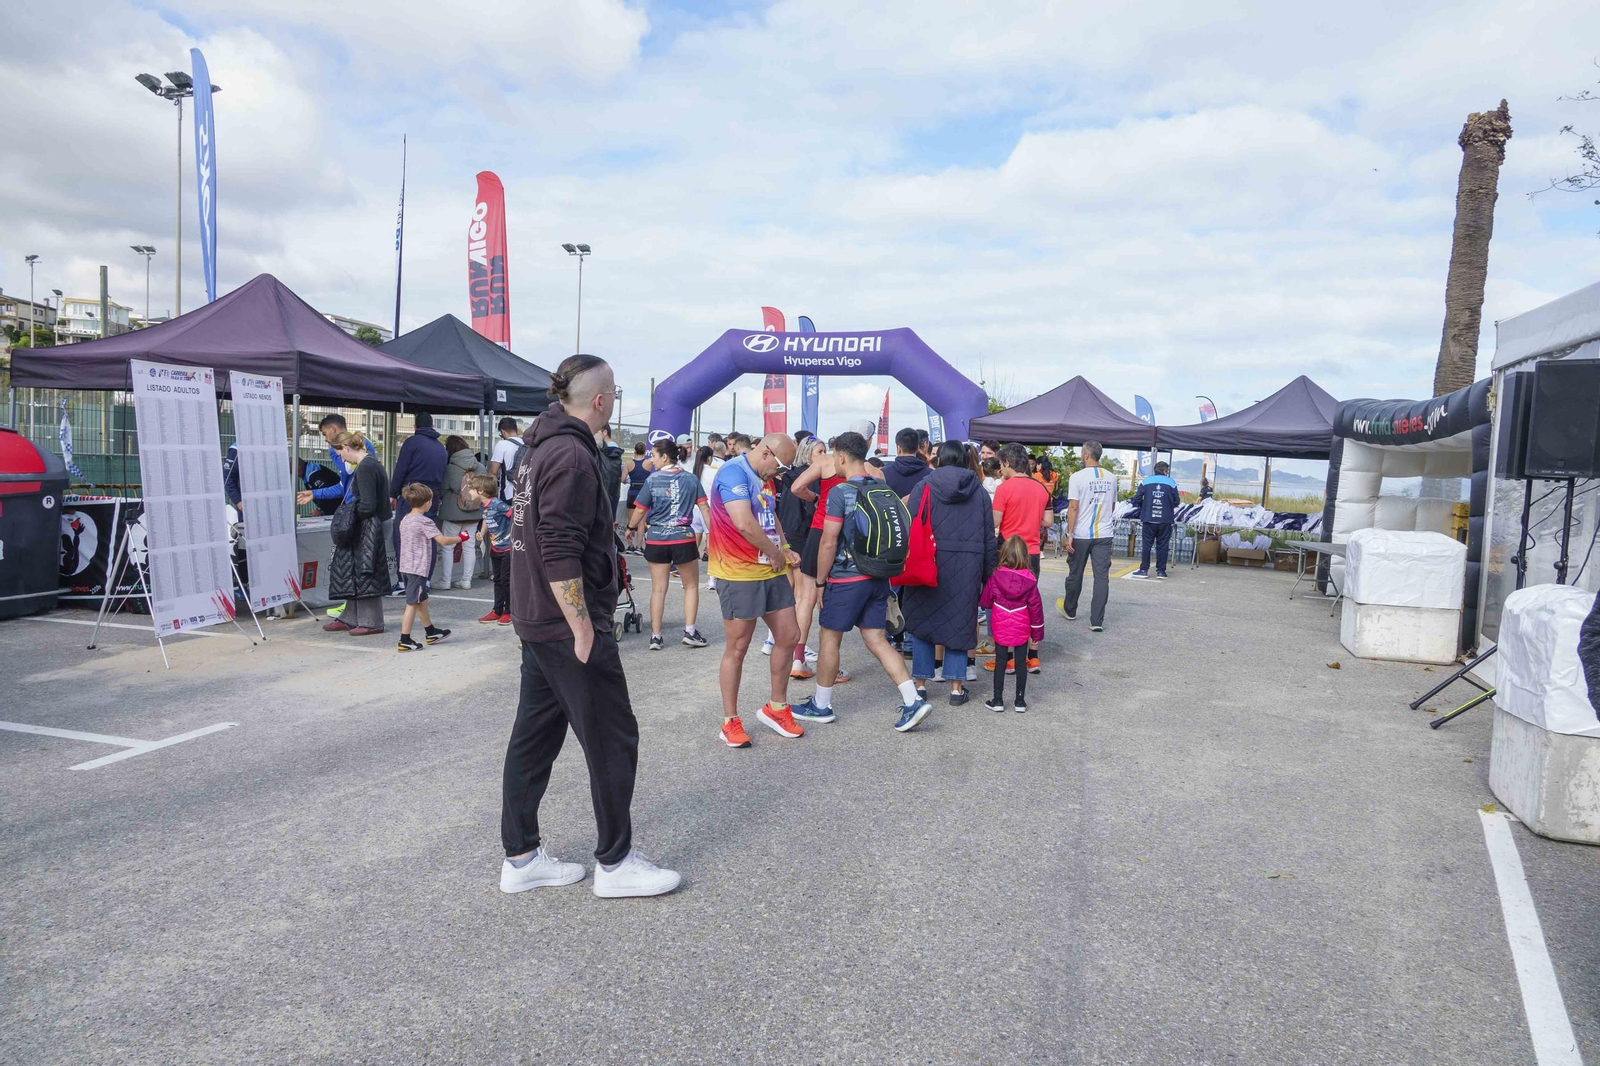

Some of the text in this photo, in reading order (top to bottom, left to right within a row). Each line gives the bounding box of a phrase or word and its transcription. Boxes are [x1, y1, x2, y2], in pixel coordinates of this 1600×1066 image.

[783, 336, 882, 352] HYUNDAI
[783, 355, 862, 368] Hyupersa Vigo
[146, 384, 201, 395] LISTADO ADULTOS
[242, 392, 272, 401] LISTADO NENOS
[889, 506, 902, 547] NABAIJI
